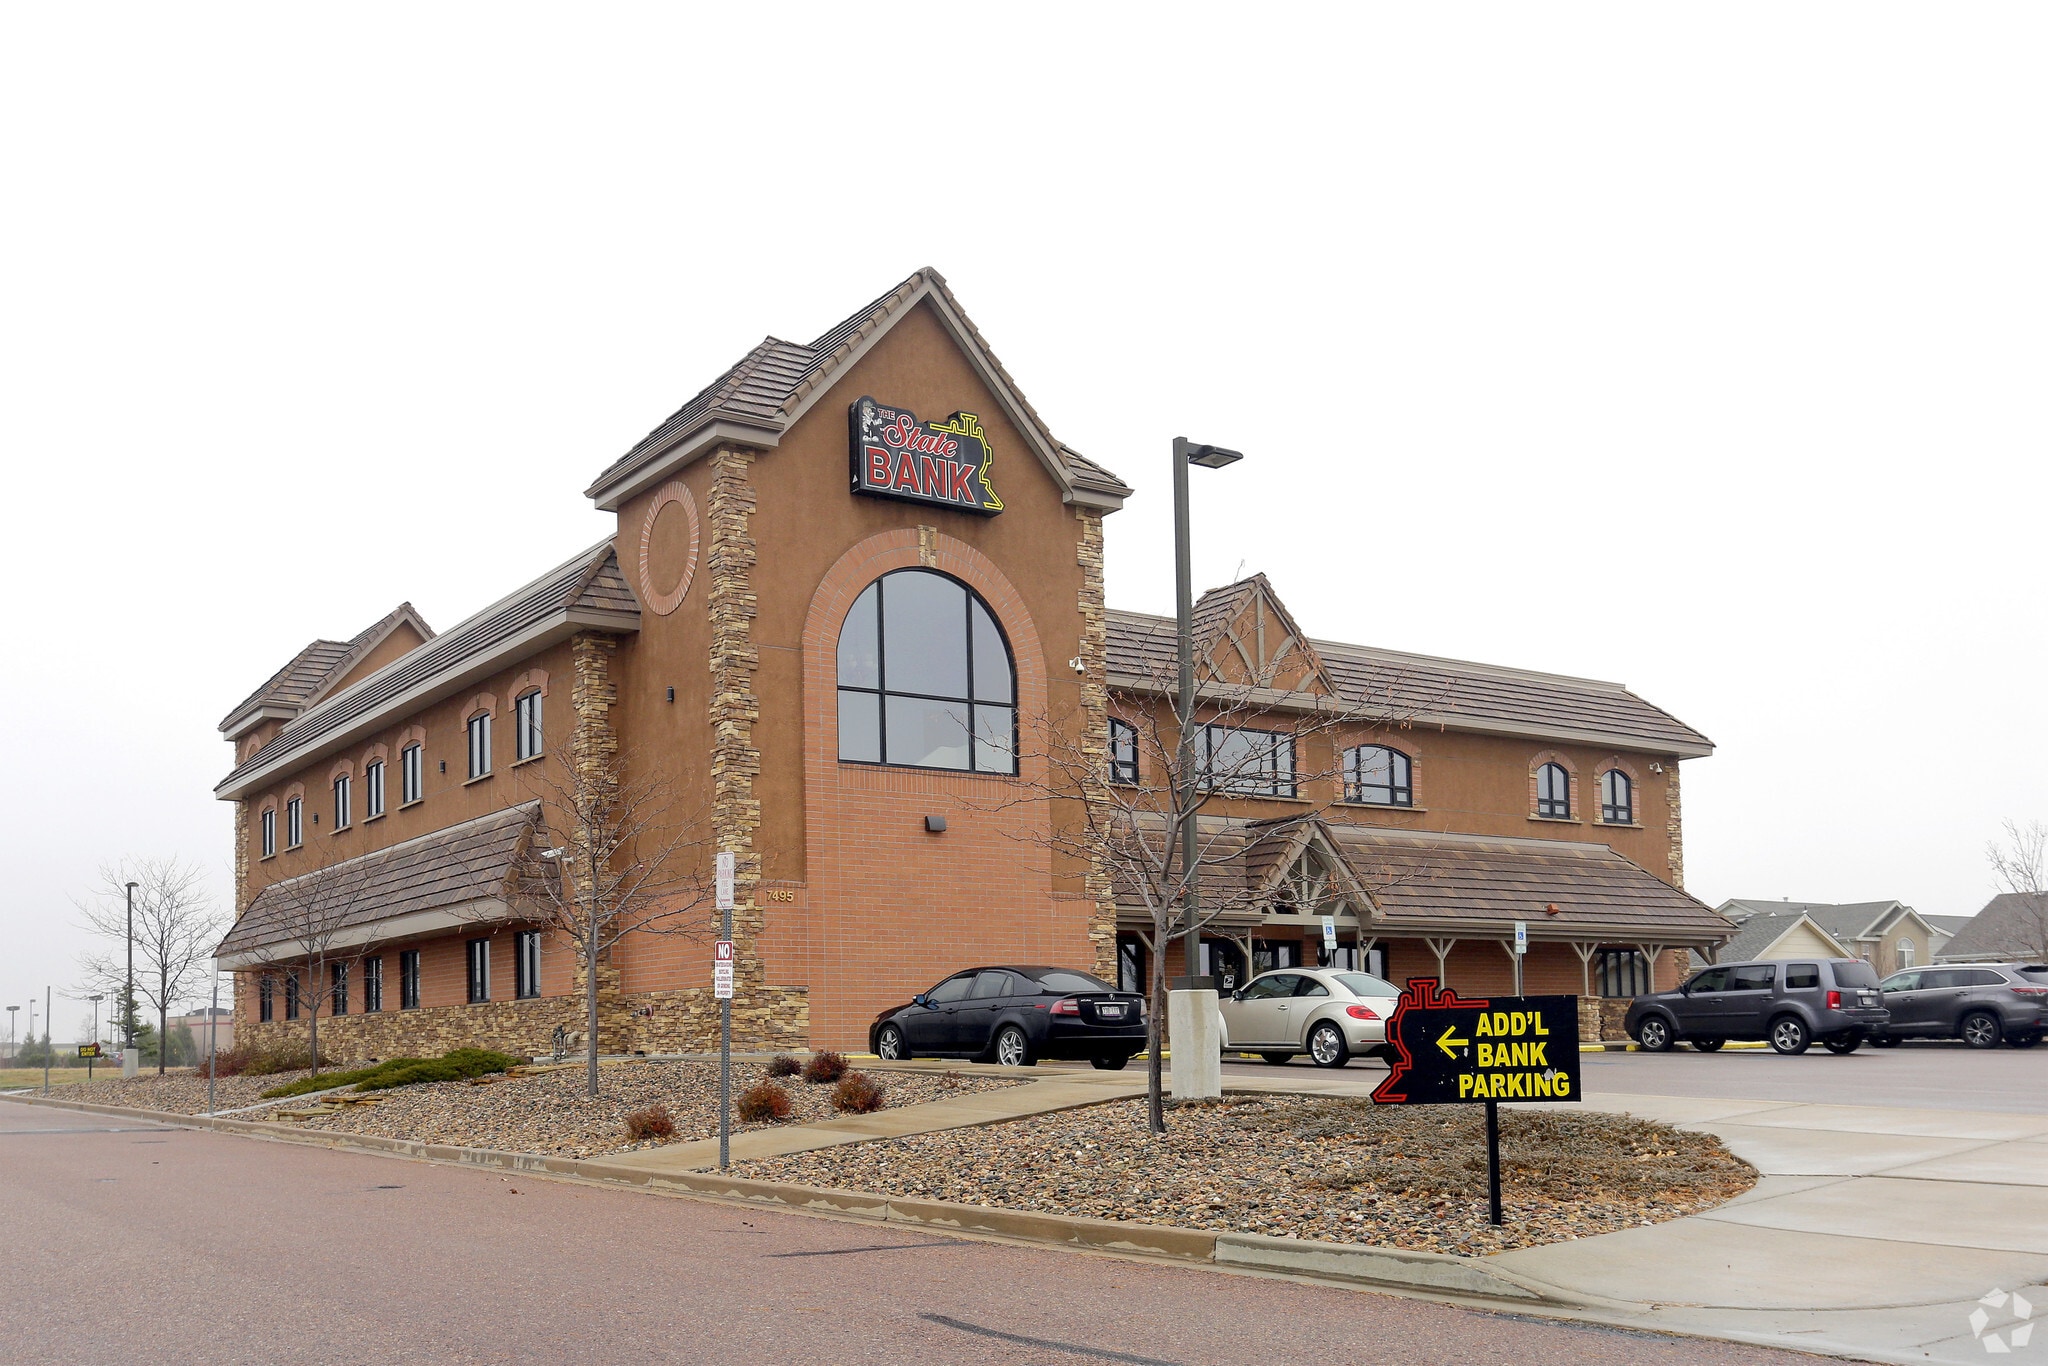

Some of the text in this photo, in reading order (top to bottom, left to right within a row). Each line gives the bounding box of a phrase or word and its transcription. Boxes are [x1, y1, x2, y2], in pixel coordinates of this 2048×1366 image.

[877, 408, 895, 420] THE
[883, 415, 958, 457] State
[864, 445, 977, 505] BANK
[766, 889, 794, 902] 7495
[718, 943, 730, 959] NO
[1475, 1011, 1549, 1037] ADD'L
[1477, 1041, 1548, 1068] BANK
[1458, 1072, 1570, 1098] PARKING
